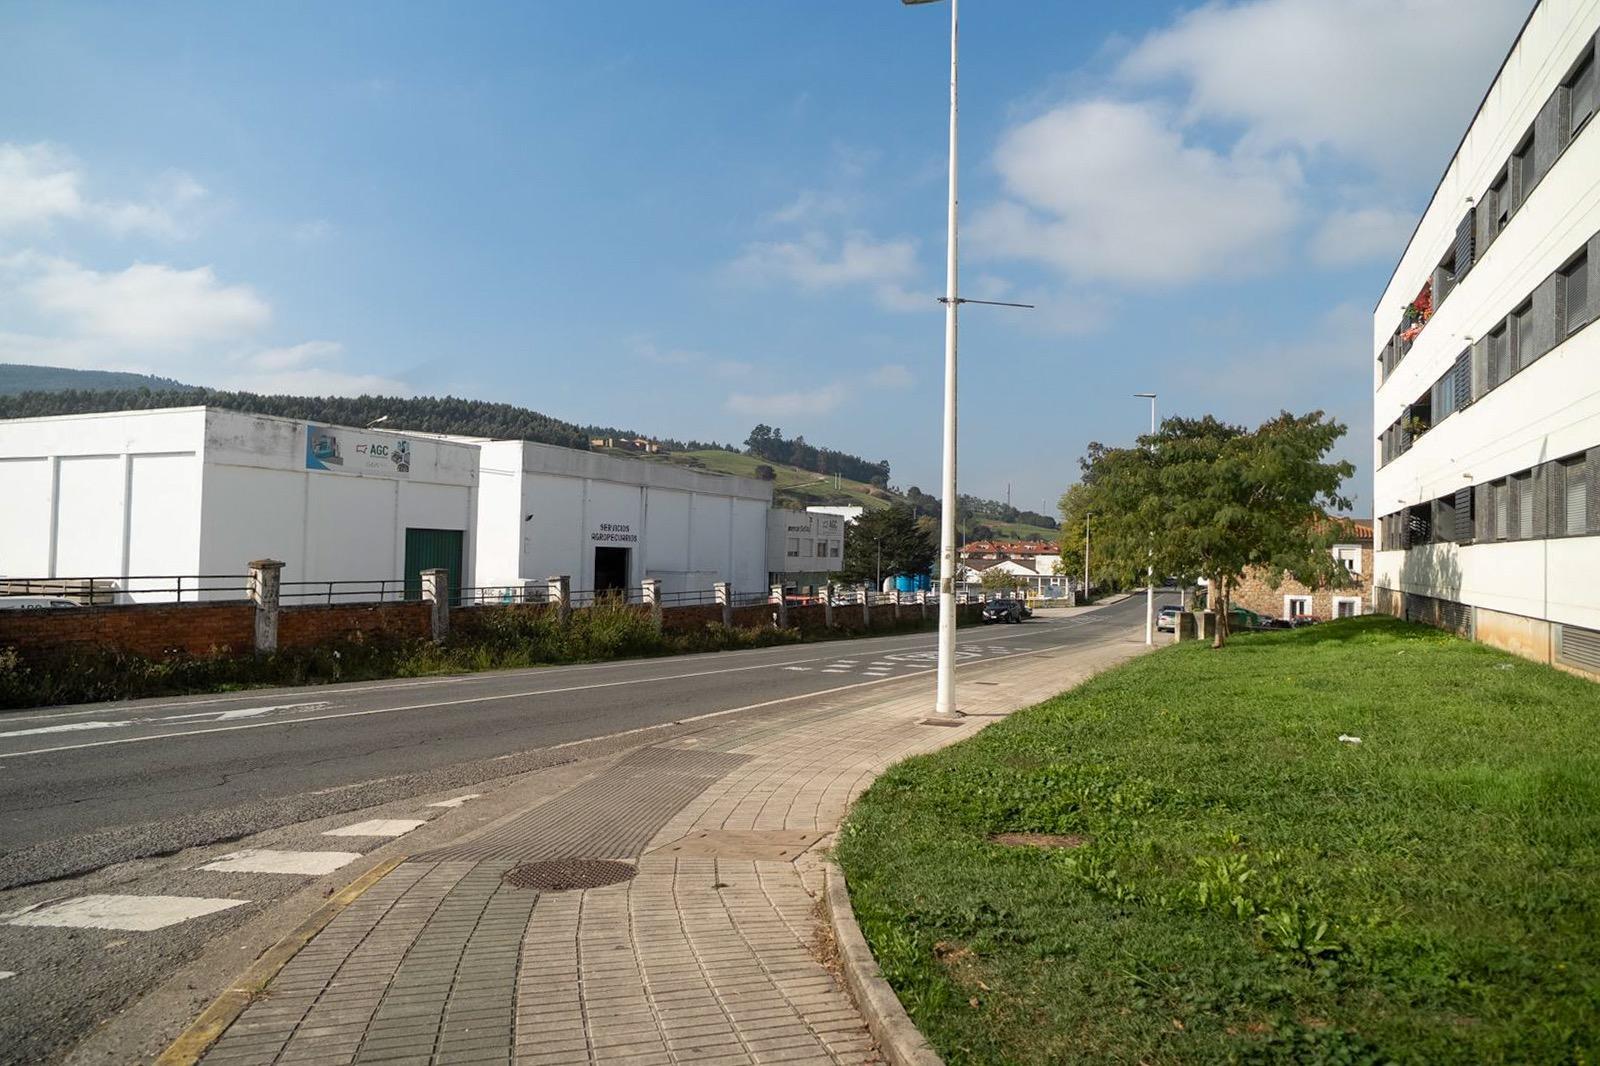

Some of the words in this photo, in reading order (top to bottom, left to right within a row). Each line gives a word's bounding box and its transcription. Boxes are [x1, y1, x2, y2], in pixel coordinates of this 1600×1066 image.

[370, 444, 389, 456] AGC
[600, 524, 630, 532] SERVICIOS
[591, 532, 638, 542] AGROPECUARIOS
